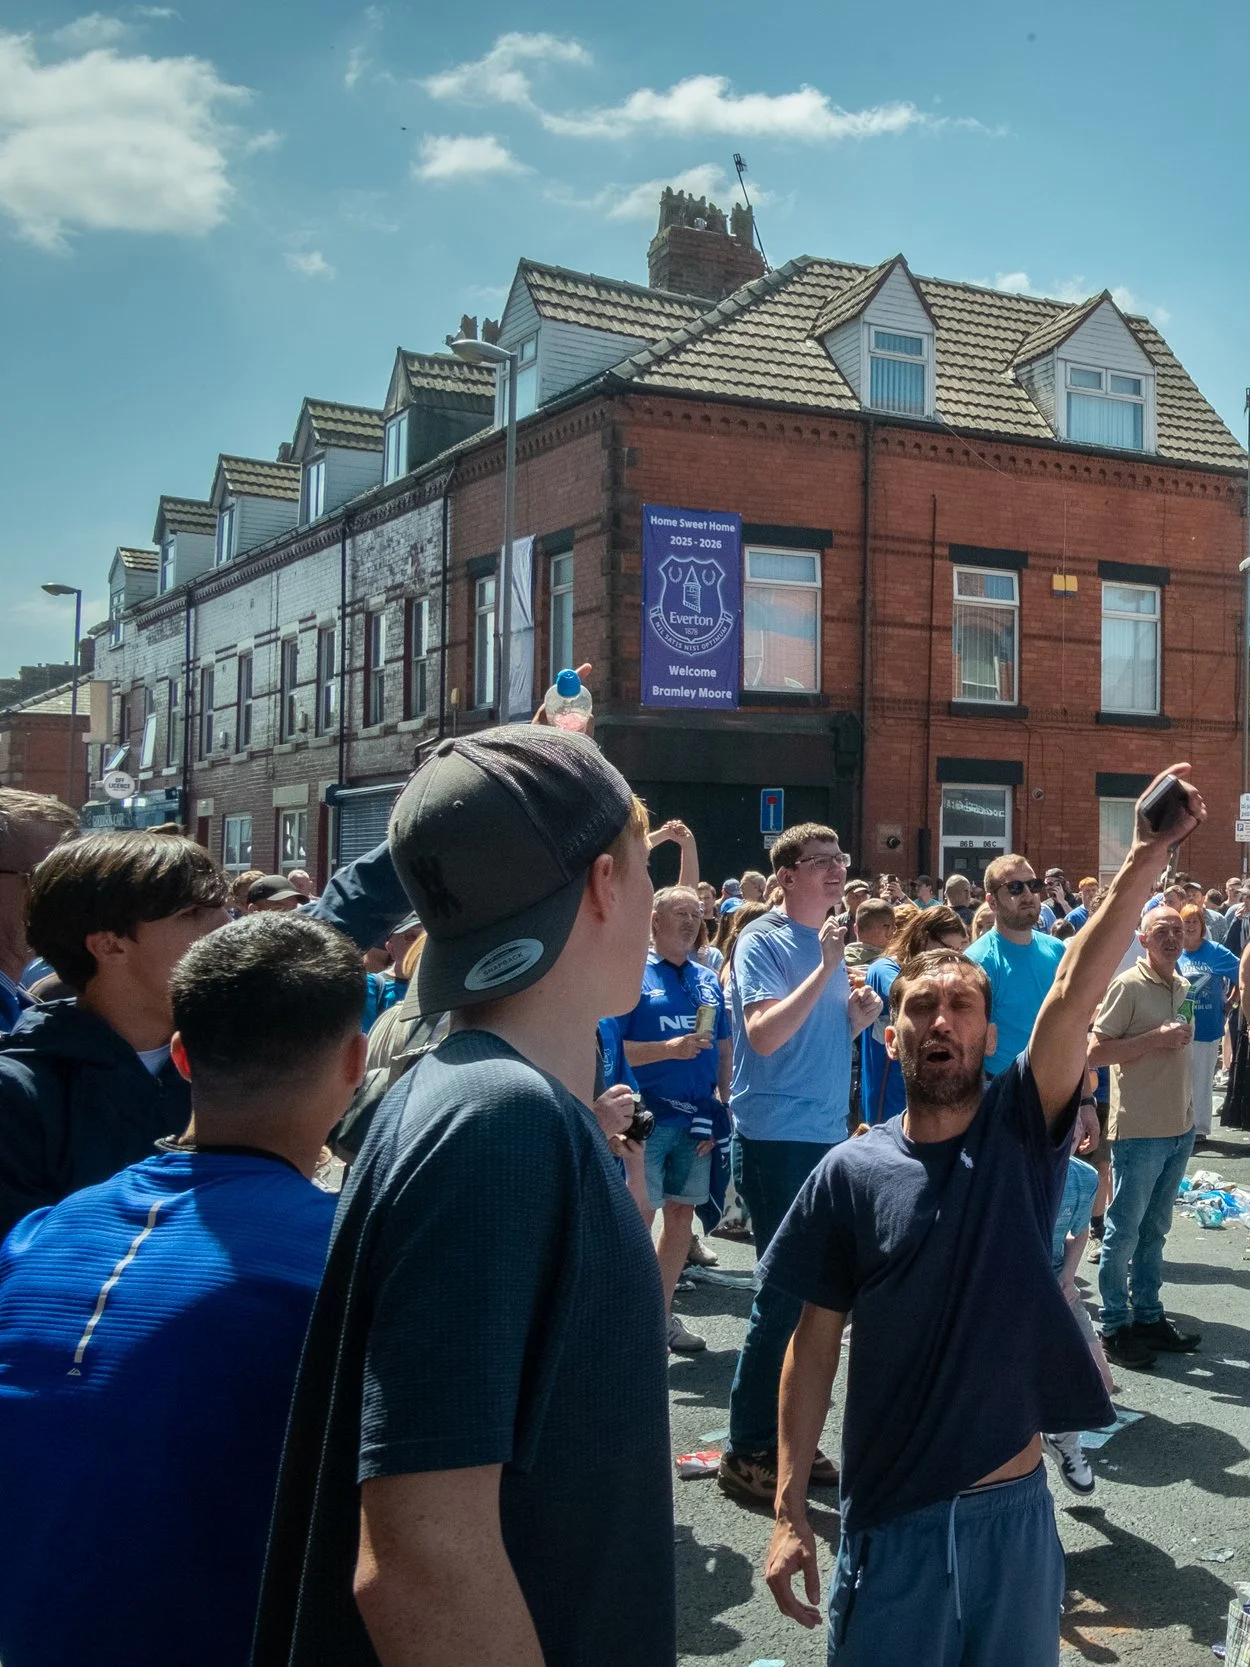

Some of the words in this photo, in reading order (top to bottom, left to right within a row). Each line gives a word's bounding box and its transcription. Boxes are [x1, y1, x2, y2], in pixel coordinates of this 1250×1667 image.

[650, 516, 678, 528] Home
[679, 518, 708, 530] Sweet
[708, 521, 736, 532] Home
[670, 536, 693, 547] 2025
[699, 537, 722, 549] 2026
[669, 611, 714, 627] Everton
[654, 620, 666, 635] NIL
[668, 664, 717, 678] Welcome
[652, 685, 697, 700] Bramley
[698, 687, 733, 699] Moore
[482, 951, 524, 976] SNAPBACK
[659, 1015, 697, 1032] NE
